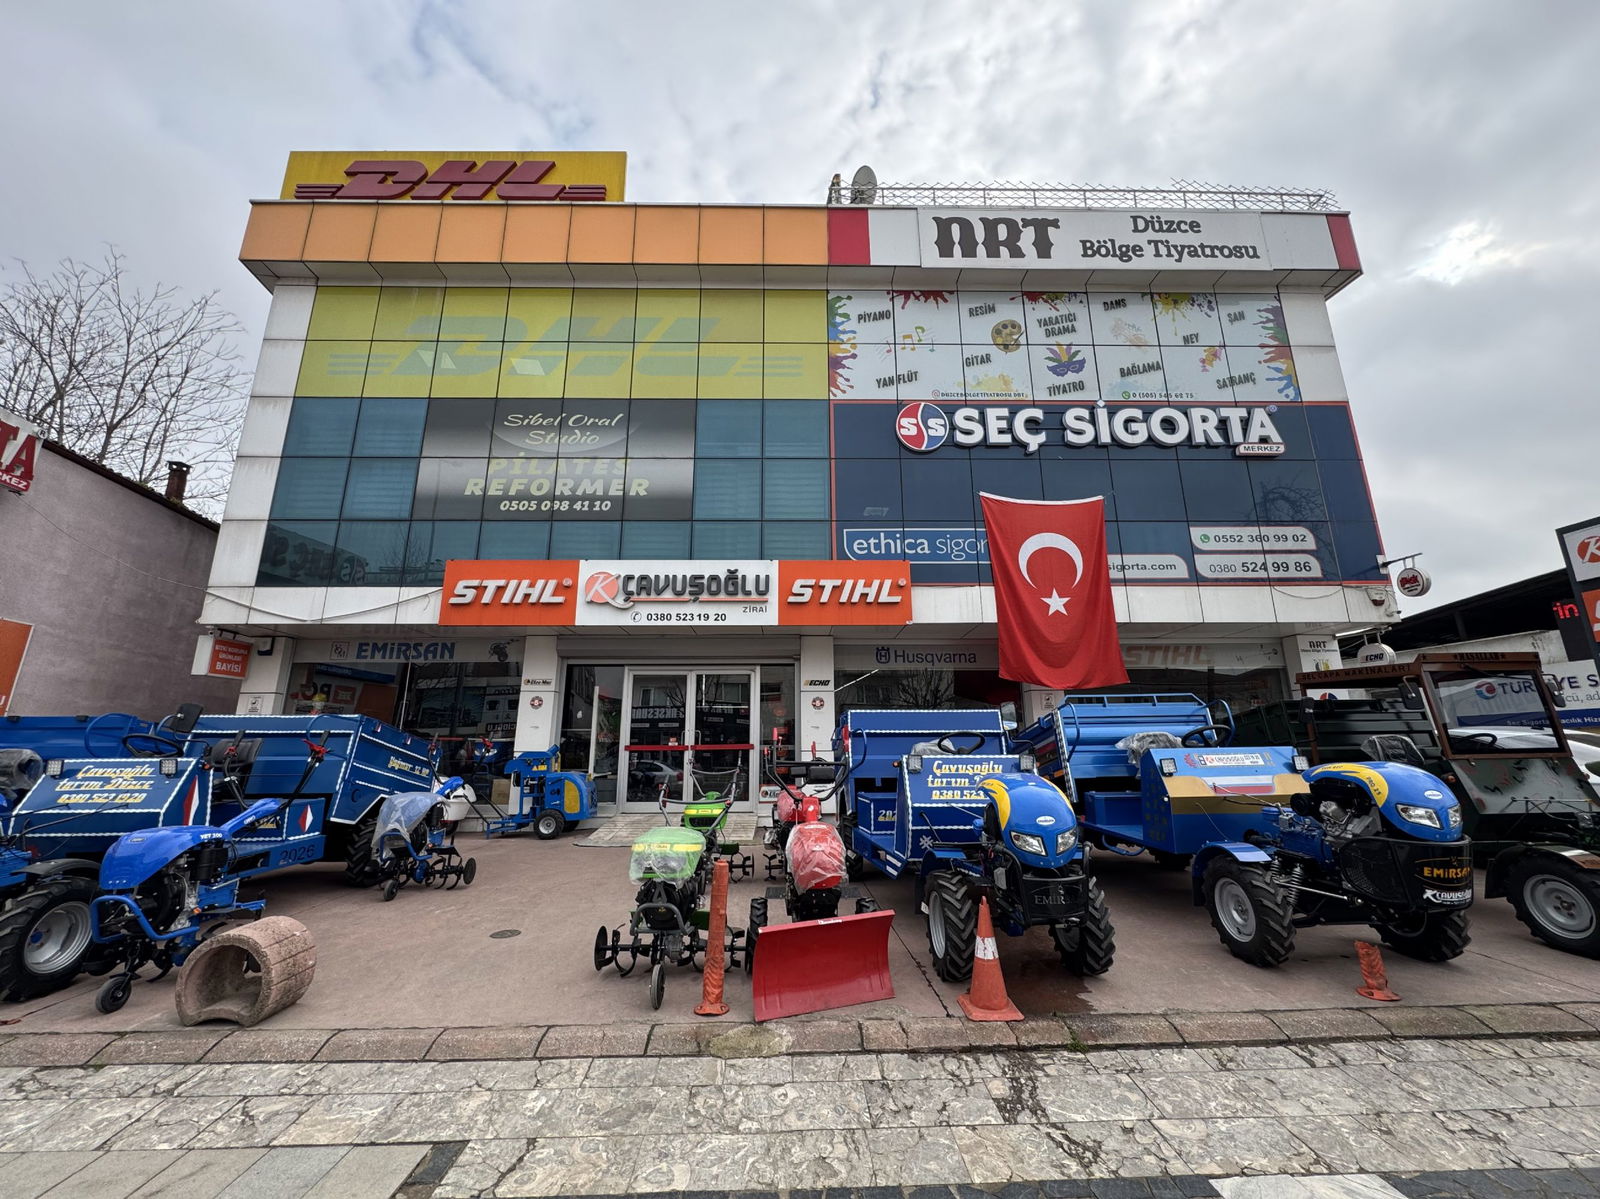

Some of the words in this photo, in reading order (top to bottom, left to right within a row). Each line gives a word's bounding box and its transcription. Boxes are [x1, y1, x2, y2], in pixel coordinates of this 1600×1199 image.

[334, 160, 567, 201] DHL
[1130, 215, 1202, 234] Düzce
[1080, 239, 1144, 262] Bölge
[1147, 239, 1261, 262] Tiyatrosu
[968, 303, 996, 318] RESİM
[1103, 298, 1127, 311] DANS
[857, 309, 892, 324] PİYANO
[1036, 312, 1077, 328] YARATICI
[1227, 311, 1246, 325] ŞAN
[1045, 325, 1077, 338] DRAMA
[1183, 332, 1199, 345] NEY
[965, 352, 992, 367] GİTAR
[1119, 360, 1162, 378] BAĞLAMA
[876, 376, 895, 389] YAN
[897, 371, 919, 385] FLÜT
[1216, 372, 1256, 390] SATRANÇ
[1047, 380, 1085, 397] TİYATRO
[503, 413, 561, 427] Sibel
[568, 412, 624, 427] Oral
[953, 406, 1048, 455] SEÇ
[1063, 398, 1284, 447] SİGORTA
[525, 429, 600, 445] Studio
[1243, 445, 1282, 453] MERKEZ
[489, 451, 631, 475] PİLATES
[0, 472, 28, 489] KEZ
[464, 477, 650, 496] REFORMER
[500, 500, 537, 511] 0505
[573, 500, 589, 511] 41
[593, 500, 611, 511] 10
[853, 532, 931, 555] ethica
[936, 533, 988, 561] sigor
[1213, 534, 1244, 543] 0552
[1247, 534, 1270, 543] 360
[1273, 534, 1291, 543] 99
[1292, 534, 1307, 543] 02
[1209, 563, 1237, 573] 0380
[1241, 561, 1268, 573] 524
[1272, 561, 1290, 573] 99
[1294, 561, 1312, 573] 86
[448, 579, 566, 605] STIHL
[621, 568, 770, 603] ÇAVUŞOĞLU
[786, 578, 903, 604] STIHL
[646, 613, 673, 622] 0380
[675, 613, 694, 622] 523
[697, 613, 710, 622] 19
[713, 613, 727, 622] 20
[894, 650, 977, 666] Husqvarna
[1124, 646, 1215, 665] STIHL
[1365, 653, 1384, 661] ECHO
[216, 661, 241, 673] BAYİSİ
[927, 774, 970, 787] tarım
[931, 789, 961, 799] 0380
[878, 809, 897, 822] 202
[280, 844, 315, 864] 2026
